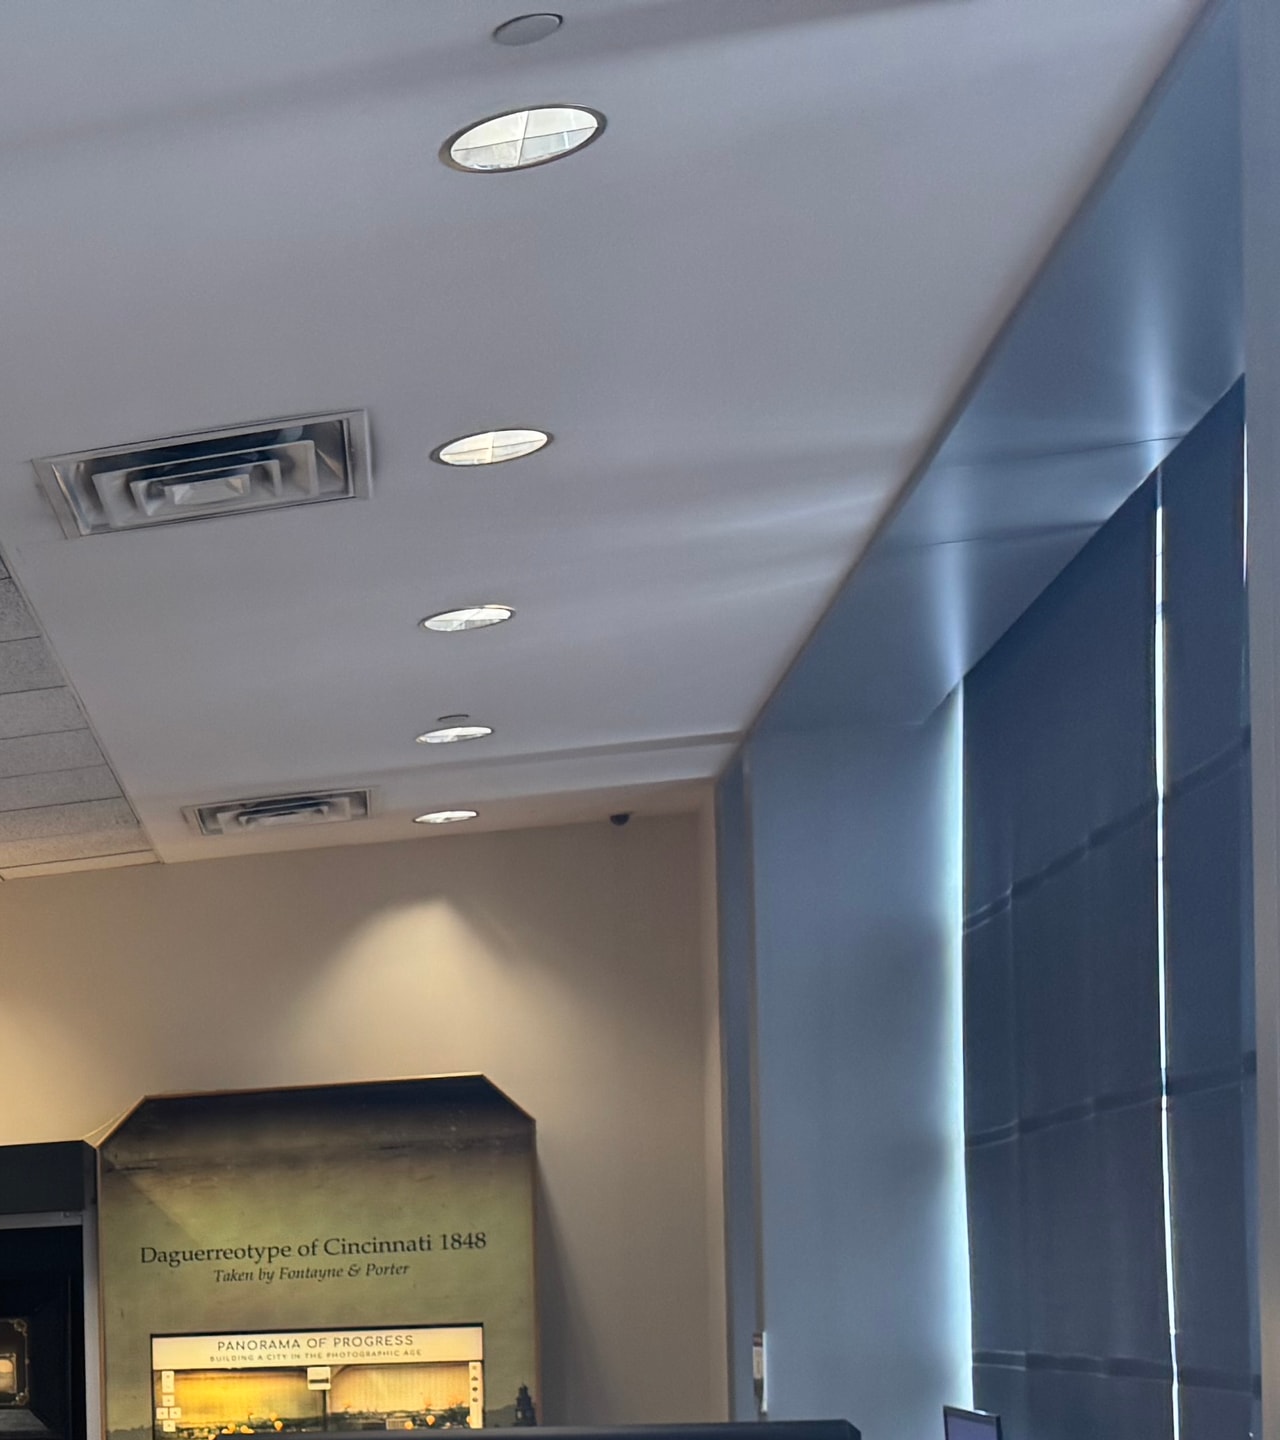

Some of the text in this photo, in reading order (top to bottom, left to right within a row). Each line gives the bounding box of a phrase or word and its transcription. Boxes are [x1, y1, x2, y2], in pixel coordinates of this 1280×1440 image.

[140, 1231, 487, 1268] Daguerreotype of Cincinnati 1848
[213, 1262, 410, 1284] Taken by Fontayne & Porter
[217, 1334, 414, 1351] PANORAMA OF PROGRESS
[209, 1354, 255, 1363] BUILDING
[267, 1353, 287, 1361] CITY
[305, 1352, 323, 1360] THE
[326, 1350, 401, 1359] PHOTOGRAPHIC
[403, 1348, 422, 1357] AGE
